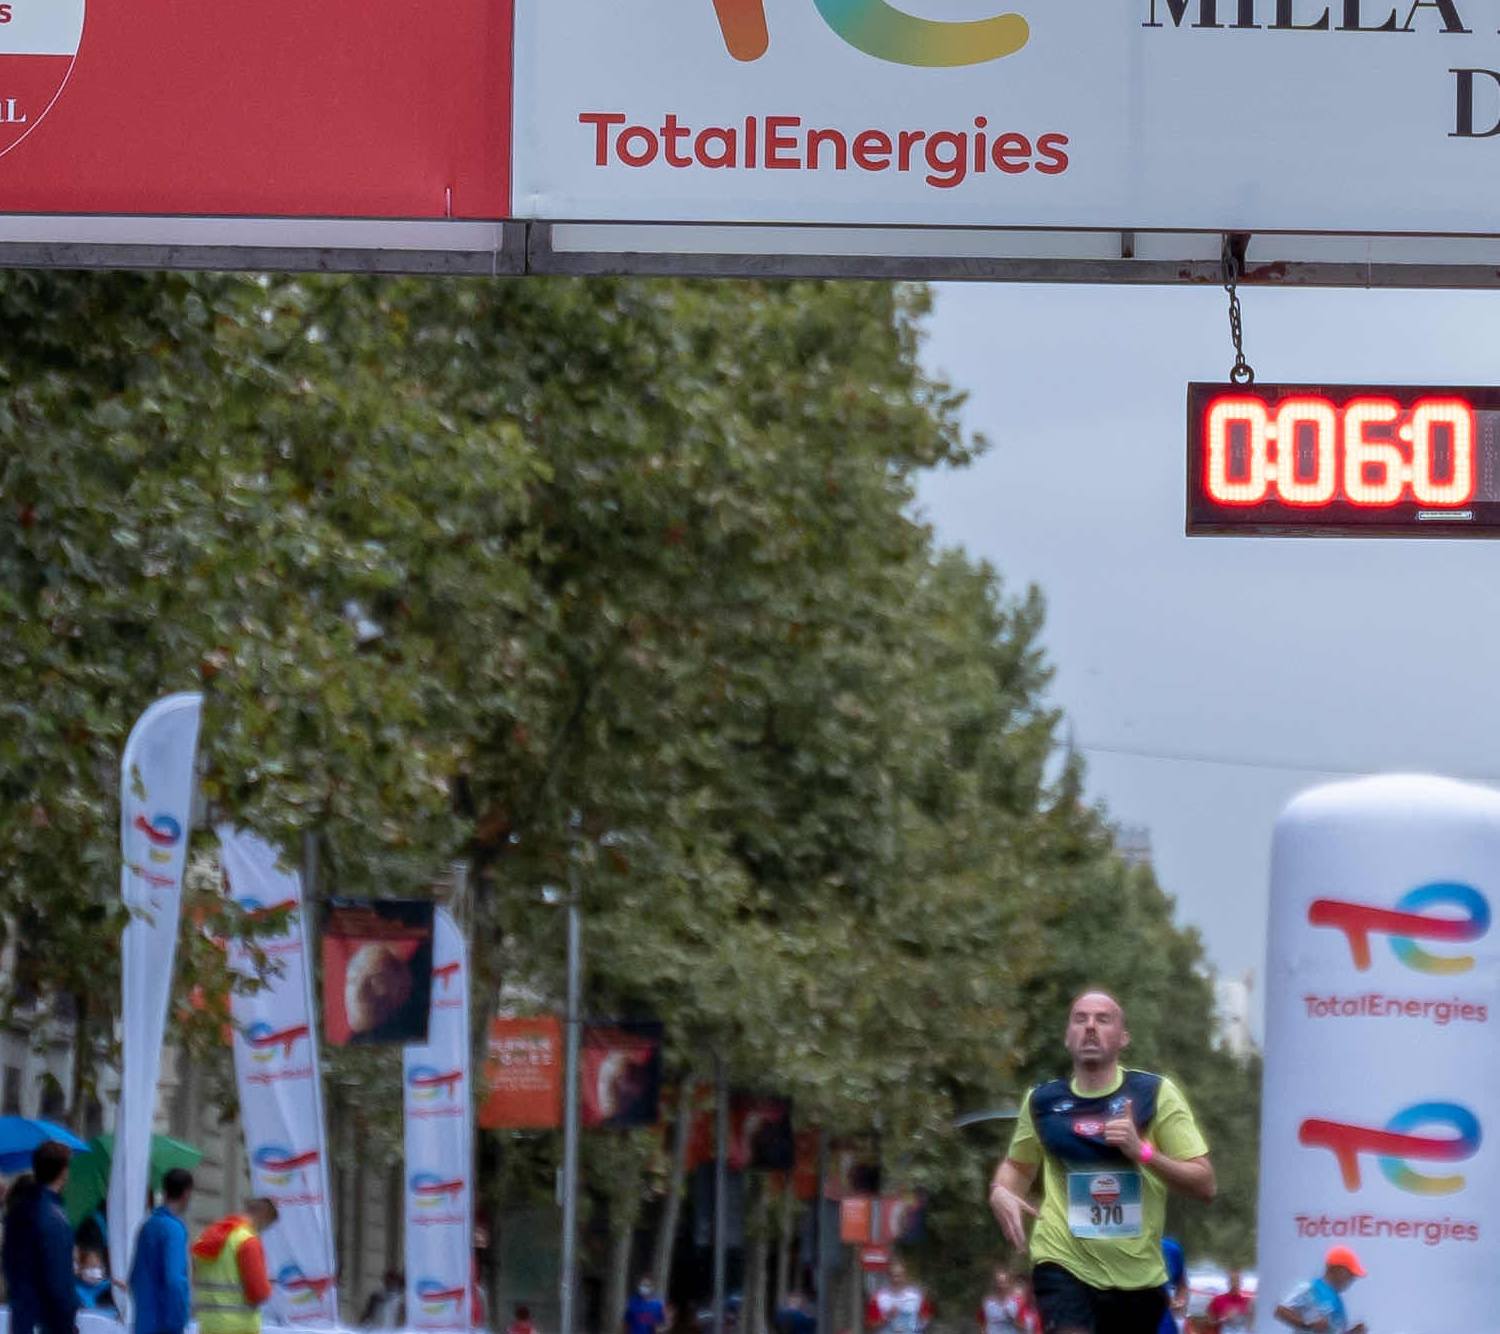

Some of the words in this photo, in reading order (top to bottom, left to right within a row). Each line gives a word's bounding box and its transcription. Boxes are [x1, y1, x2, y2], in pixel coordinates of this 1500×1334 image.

[578, 112, 1069, 189] TotalEnergies
[1303, 993, 1488, 1025] TotalEnergies
[1090, 1204, 1124, 1226] 370
[1294, 1214, 1479, 1245] TotalEnergies
